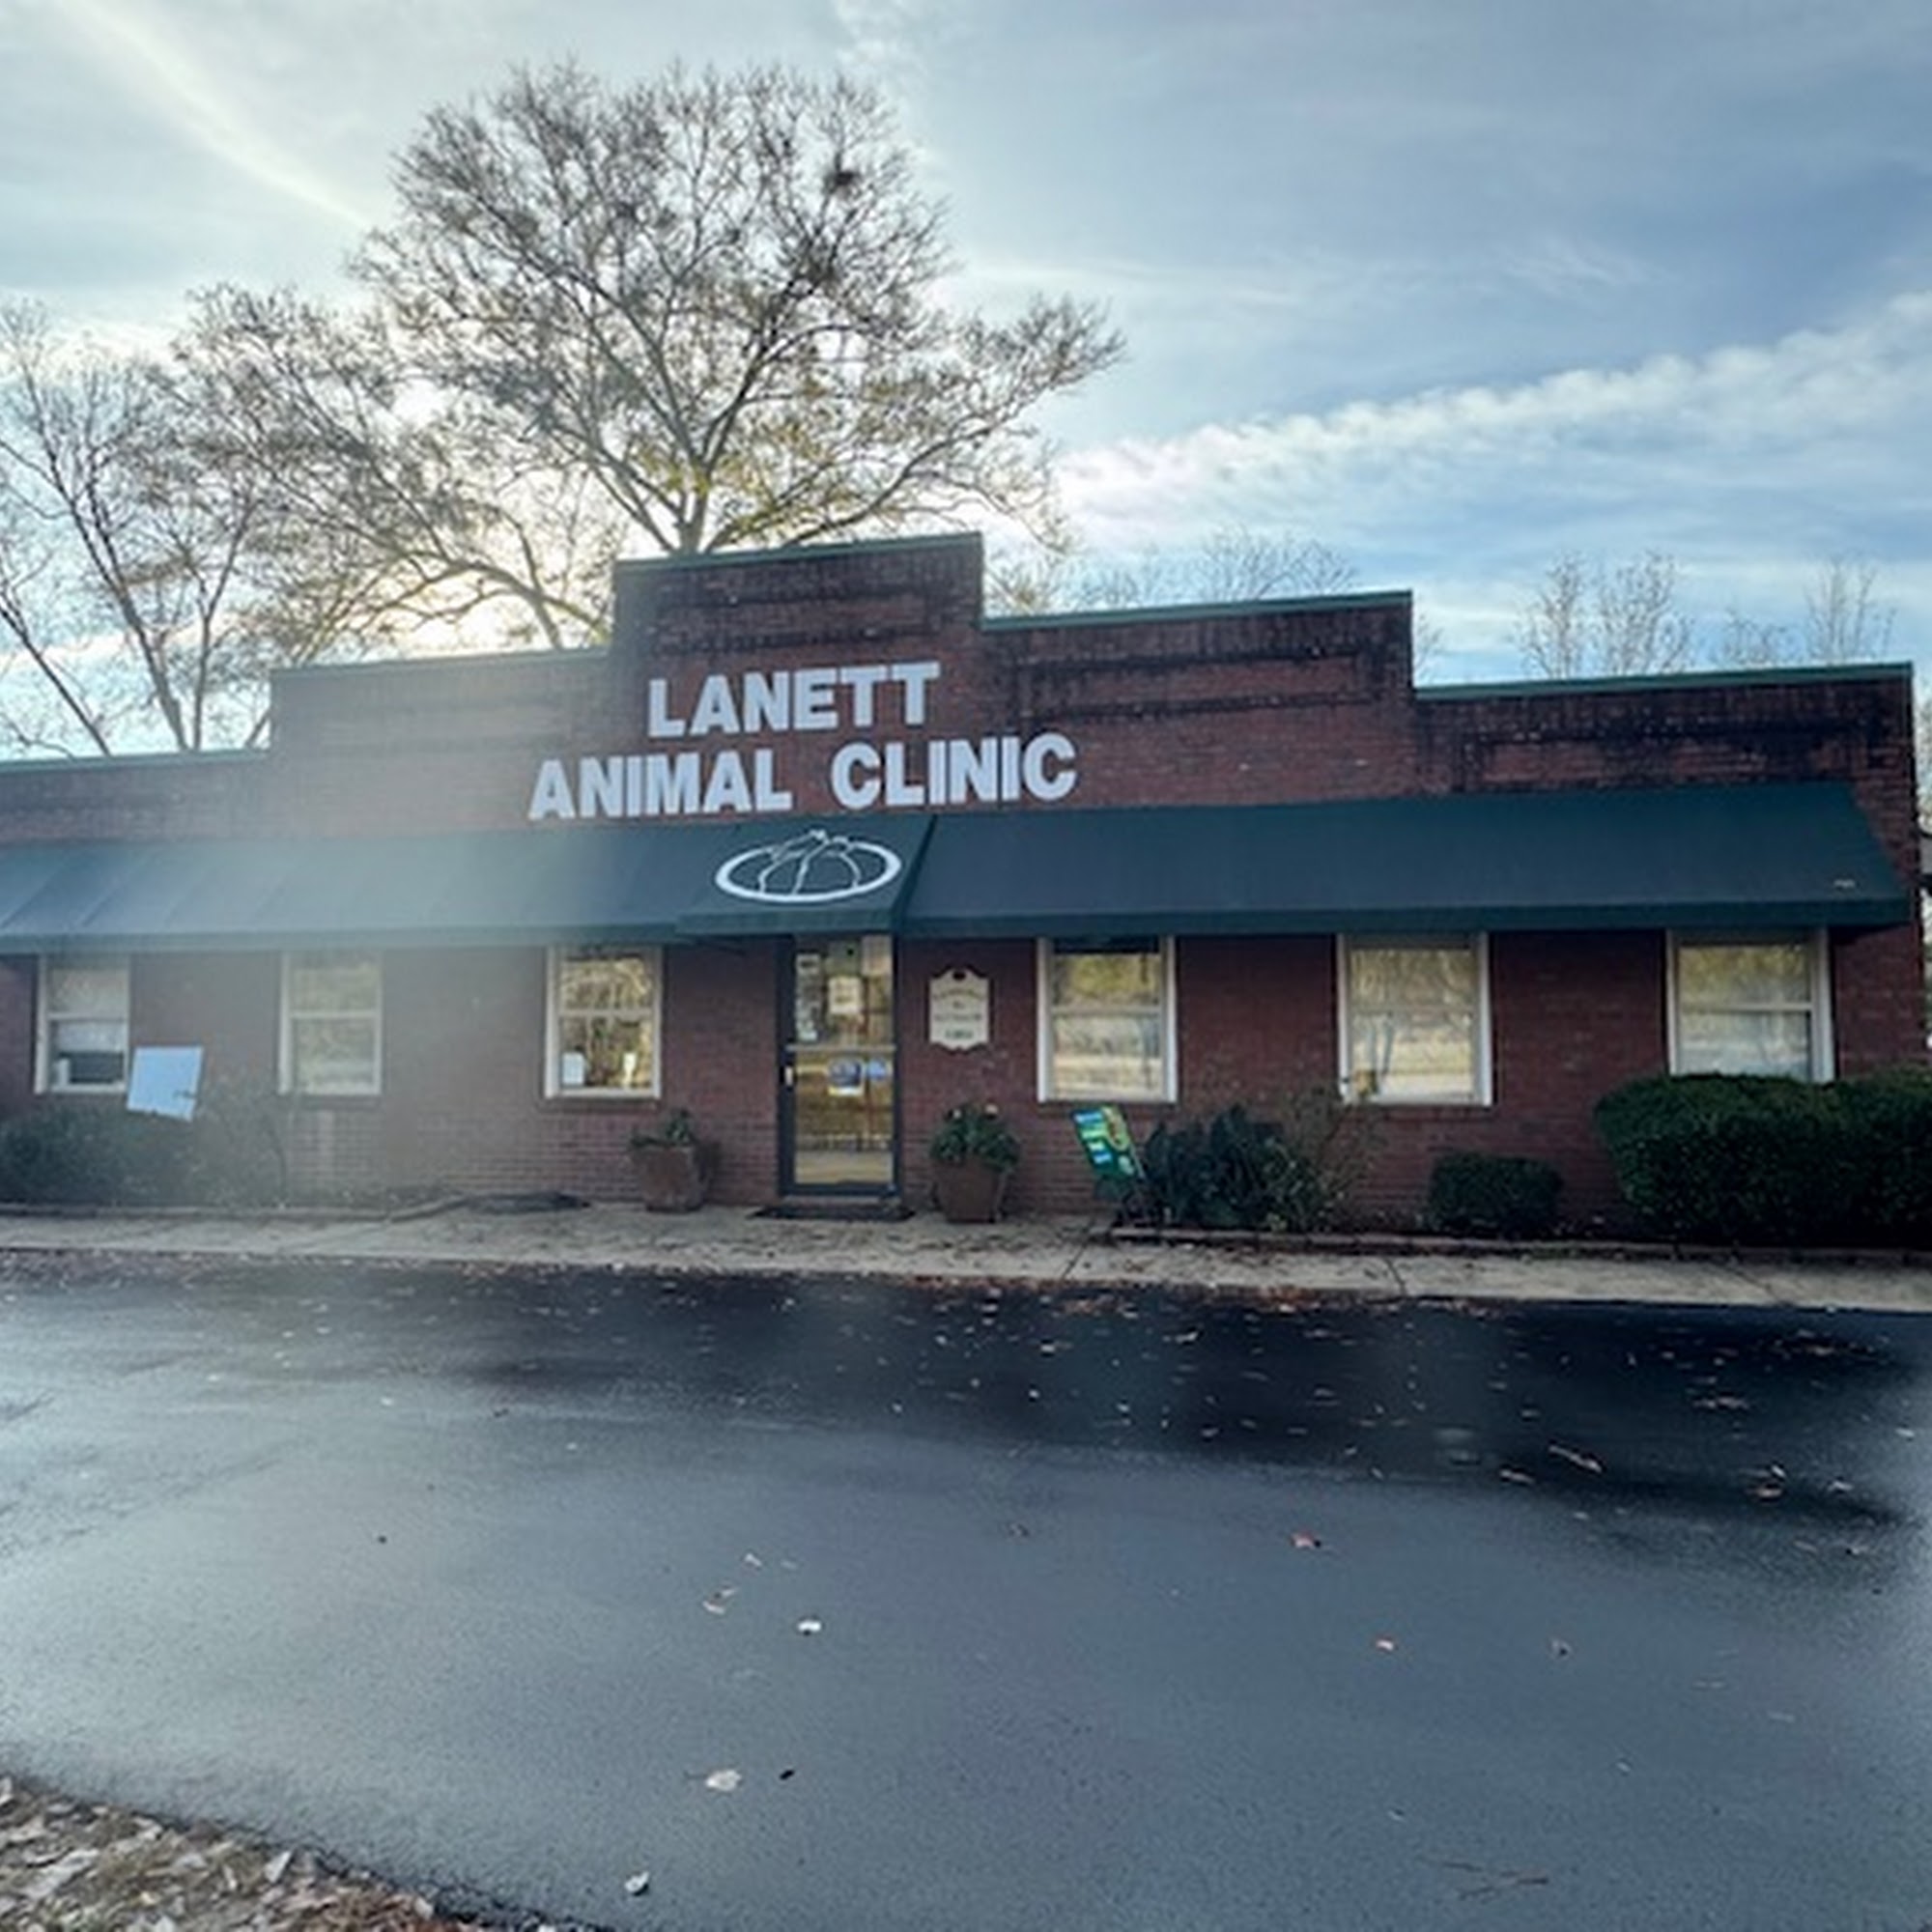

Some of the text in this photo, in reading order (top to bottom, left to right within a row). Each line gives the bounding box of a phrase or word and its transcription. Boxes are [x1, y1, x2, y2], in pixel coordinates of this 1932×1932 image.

[648, 662, 940, 738] LANETT
[526, 733, 1077, 822] ANIMAL CLINIC
